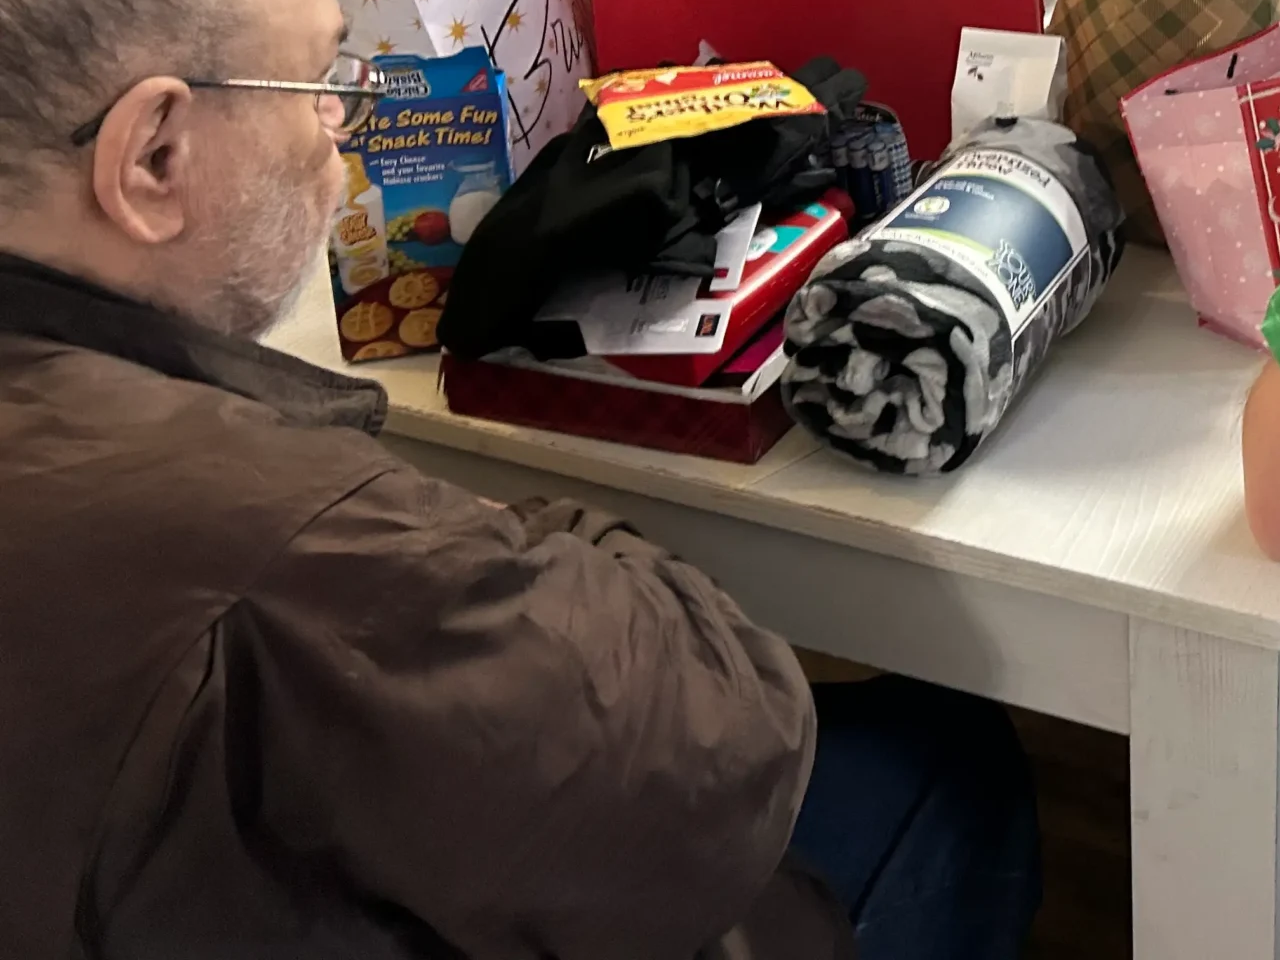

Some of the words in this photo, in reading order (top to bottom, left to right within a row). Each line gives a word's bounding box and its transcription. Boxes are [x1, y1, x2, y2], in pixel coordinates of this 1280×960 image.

[396, 107, 455, 128] Some
[459, 105, 498, 125] Fun
[367, 129, 431, 153] Snack
[434, 126, 492, 145] Time!
[380, 156, 397, 167] Easy
[399, 154, 426, 165] Cheese
[382, 167, 395, 176] and
[398, 166, 413, 177] your
[414, 172, 445, 184] crackers
[985, 245, 1026, 313] ZONE
[996, 238, 1037, 302] YOUR
